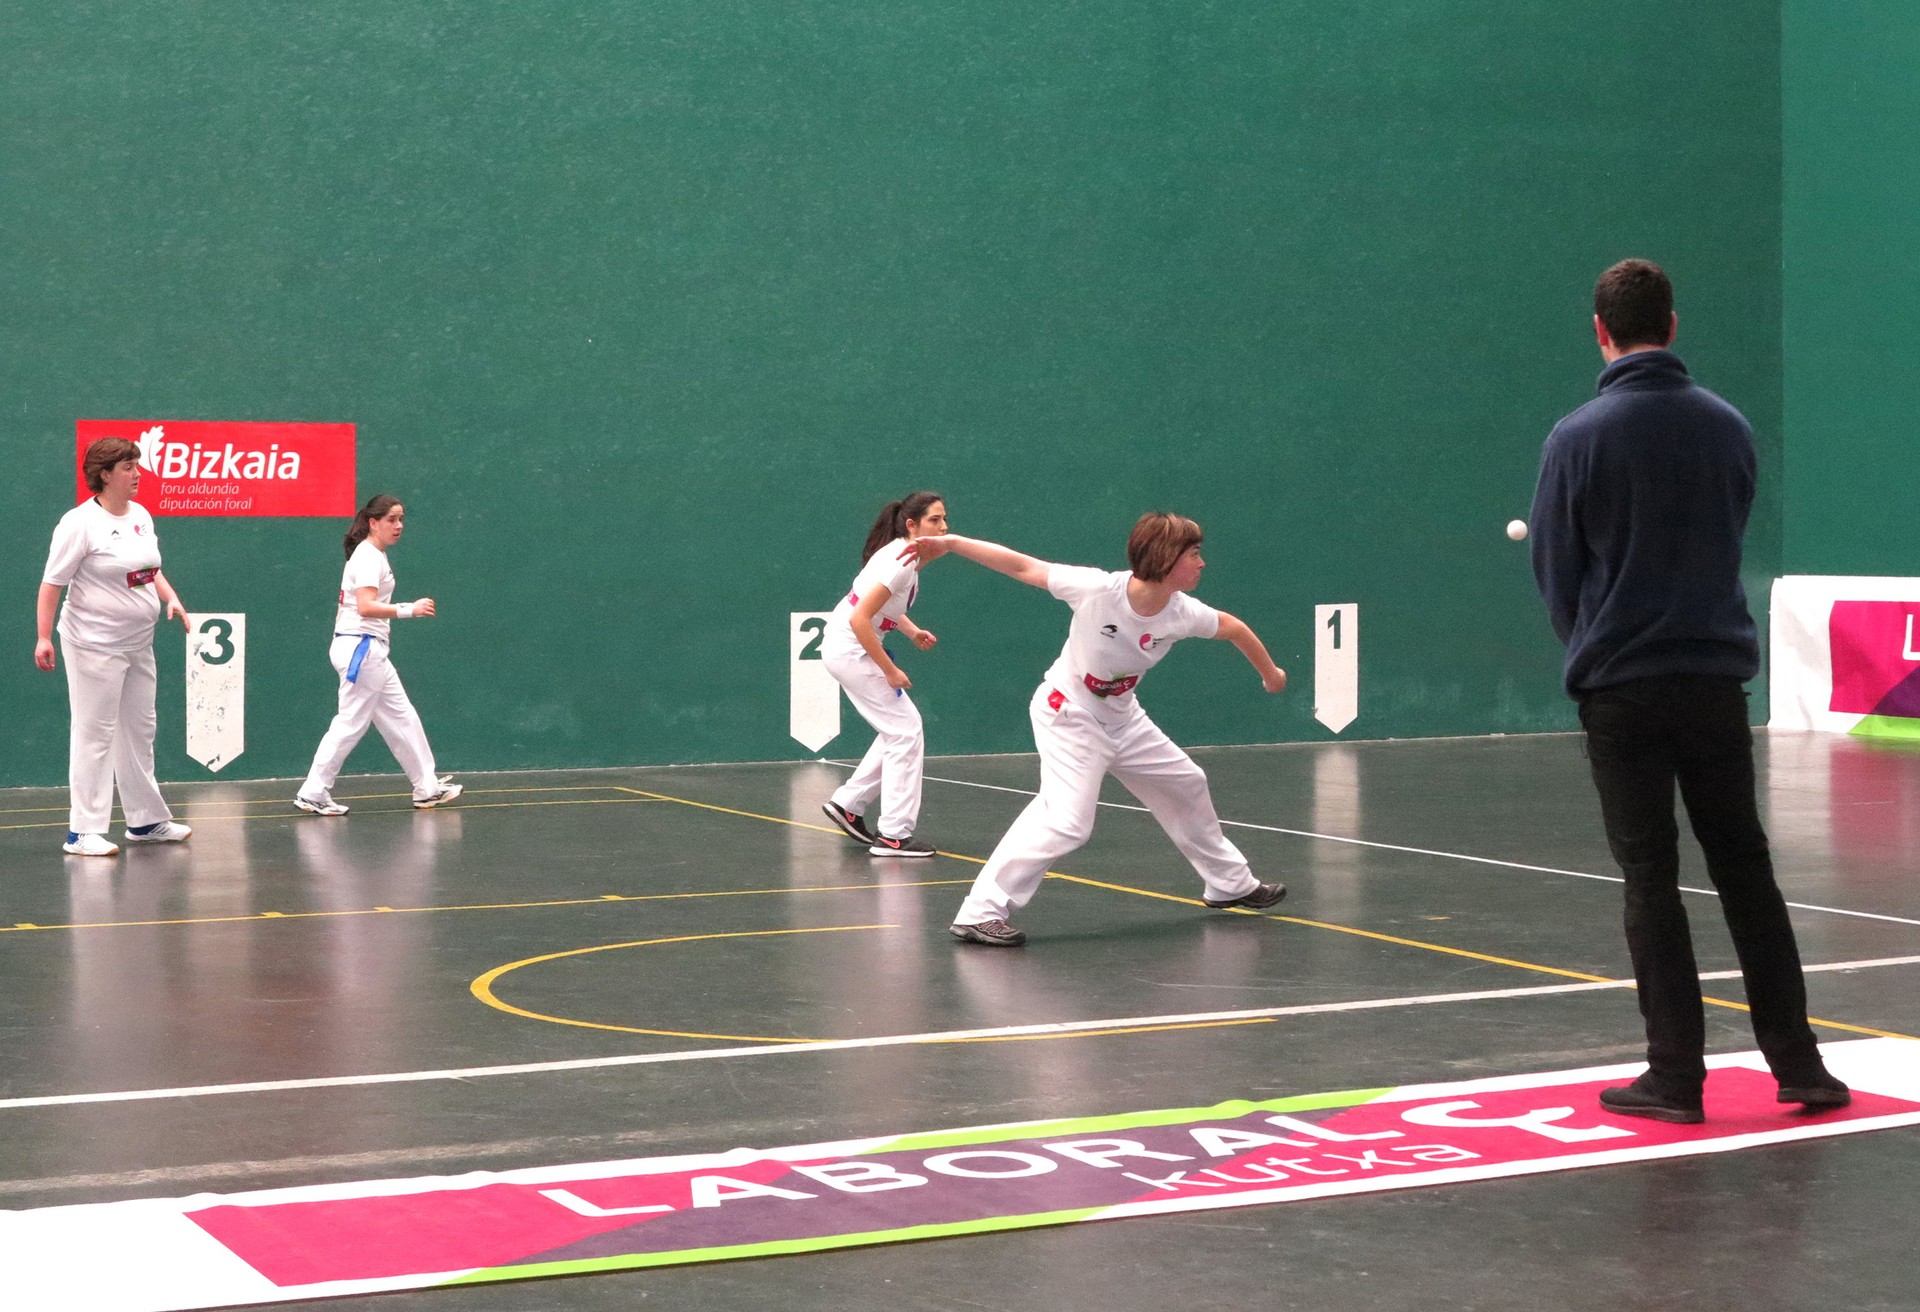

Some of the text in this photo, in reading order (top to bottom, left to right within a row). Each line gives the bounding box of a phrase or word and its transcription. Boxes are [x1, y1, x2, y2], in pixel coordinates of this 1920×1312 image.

[162, 443, 300, 480] Bizkaia
[159, 496, 252, 511] diputación foral
[160, 482, 239, 495] foru aldundia
[199, 618, 235, 665] 3
[799, 617, 828, 660] 2
[1327, 609, 1341, 649] 1
[537, 1115, 1405, 1218] LABORAL
[1121, 1143, 1482, 1192] kutxa
